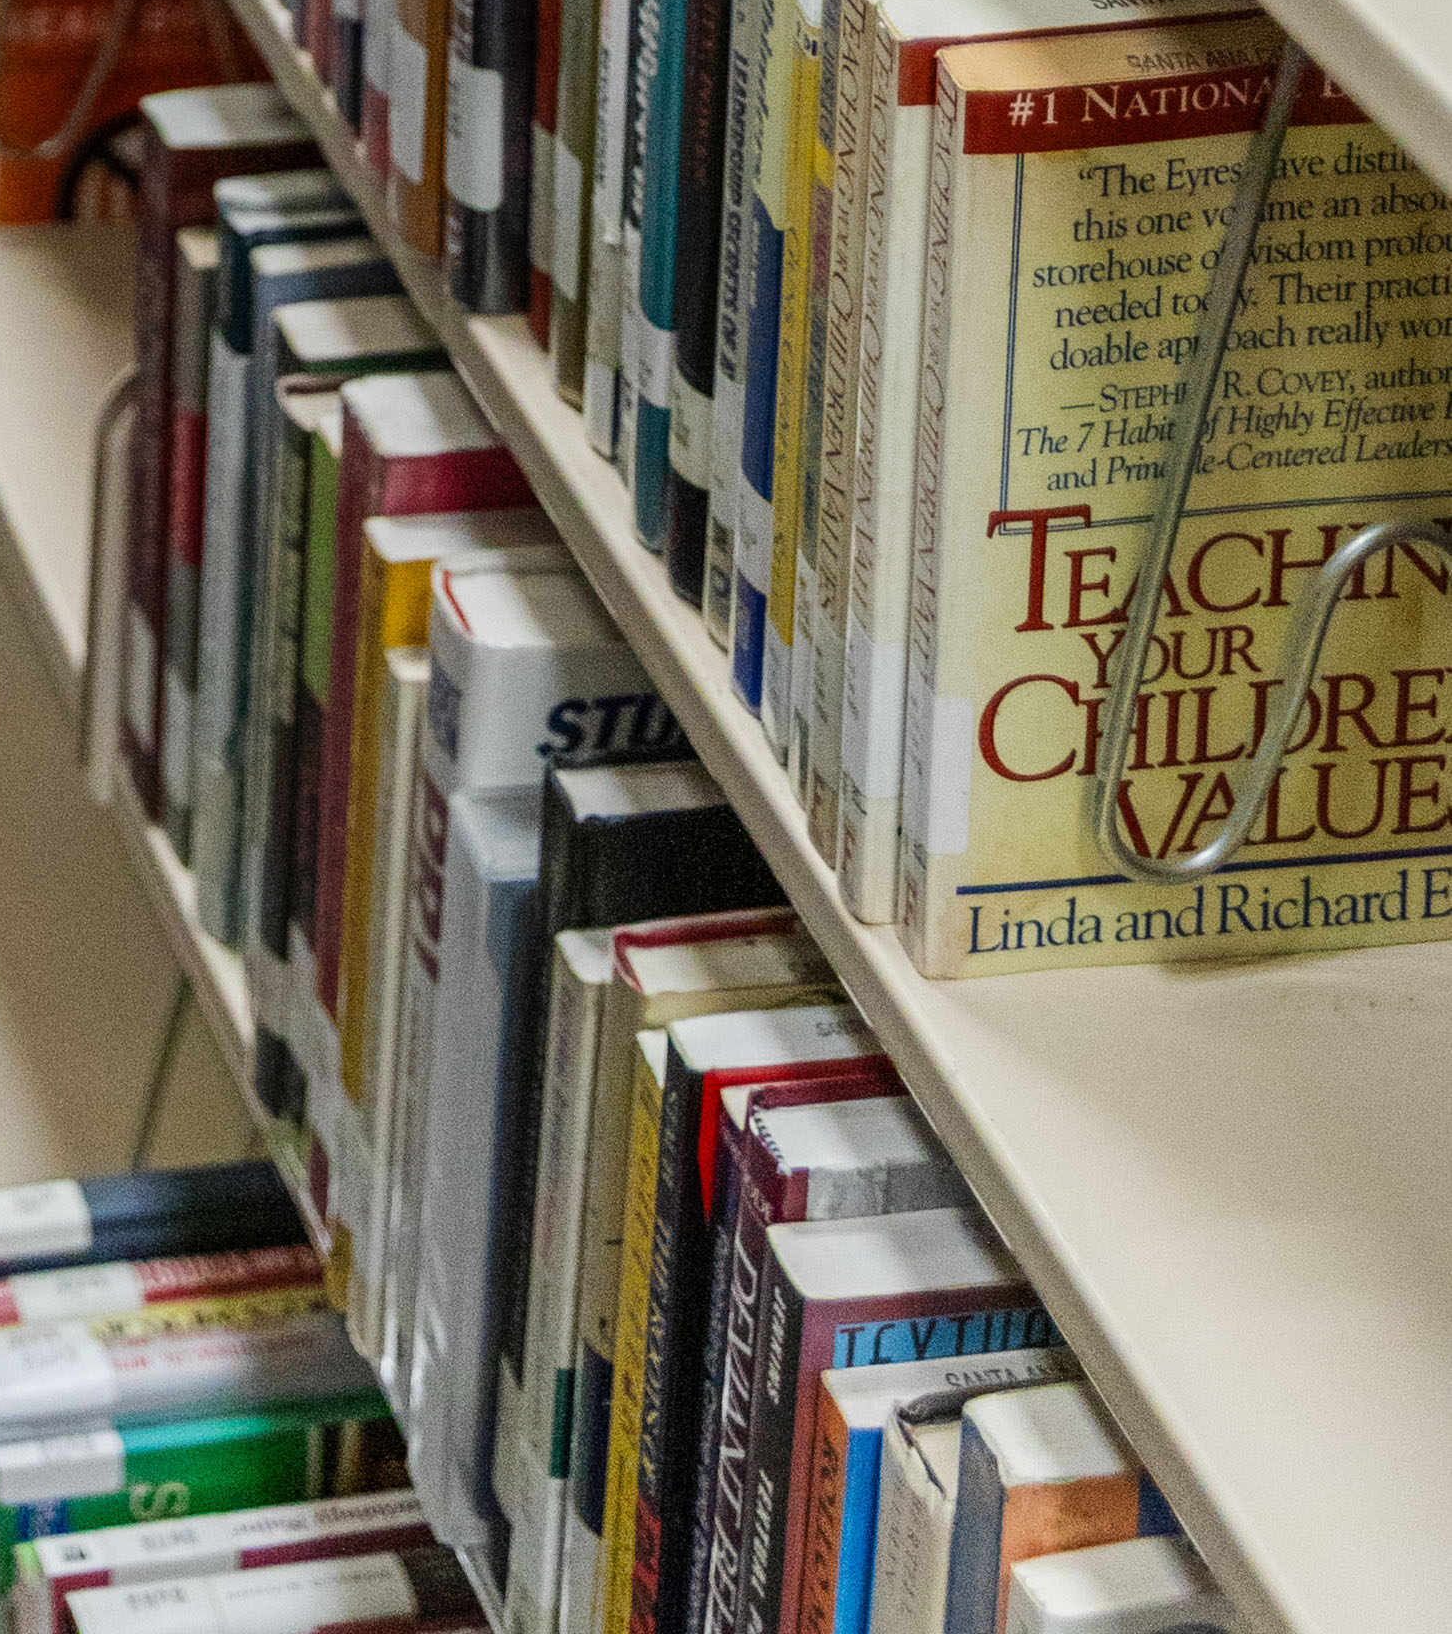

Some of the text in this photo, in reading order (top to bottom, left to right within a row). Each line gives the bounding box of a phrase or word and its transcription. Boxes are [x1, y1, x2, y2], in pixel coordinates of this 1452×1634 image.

[1008, 91, 1060, 127] #1
[1165, 156, 1244, 192] Eyres
[1071, 209, 1193, 243] this one
[1032, 244, 1192, 289] storehouse
[1054, 271, 1358, 330] needed Their
[1048, 310, 1394, 373] doable really
[1222, 368, 1255, 400] R.
[1255, 366, 1357, 398] COVEY,
[1016, 390, 1439, 457] The 7 Highly Effective
[1046, 459, 1098, 491] and
[1077, 622, 1264, 691] YOUR
[967, 866, 1410, 956] Linda and Richard
